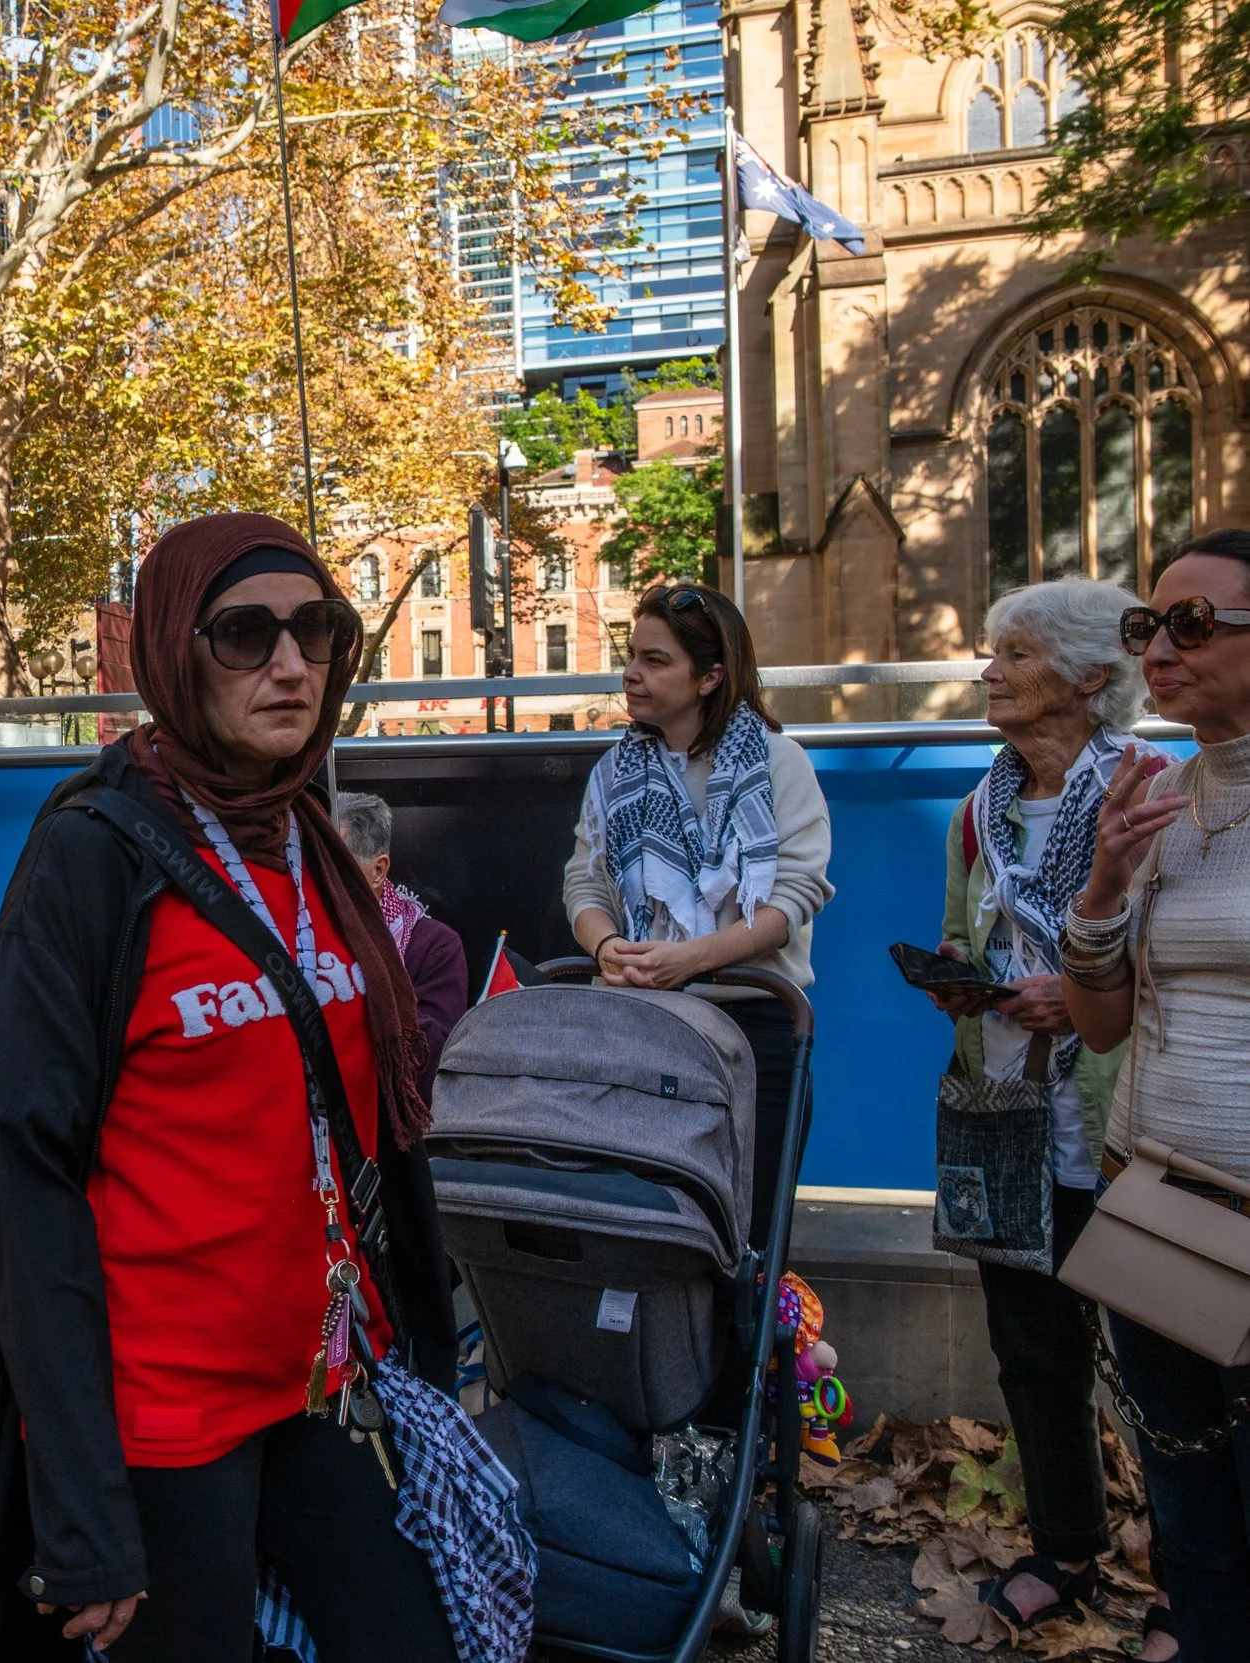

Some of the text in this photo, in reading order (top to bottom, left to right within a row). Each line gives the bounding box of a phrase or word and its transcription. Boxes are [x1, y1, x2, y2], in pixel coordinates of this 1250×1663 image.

[418, 699, 449, 712] KFC
[134, 821, 225, 905] MIMCO
[664, 1085, 675, 1094] V2
